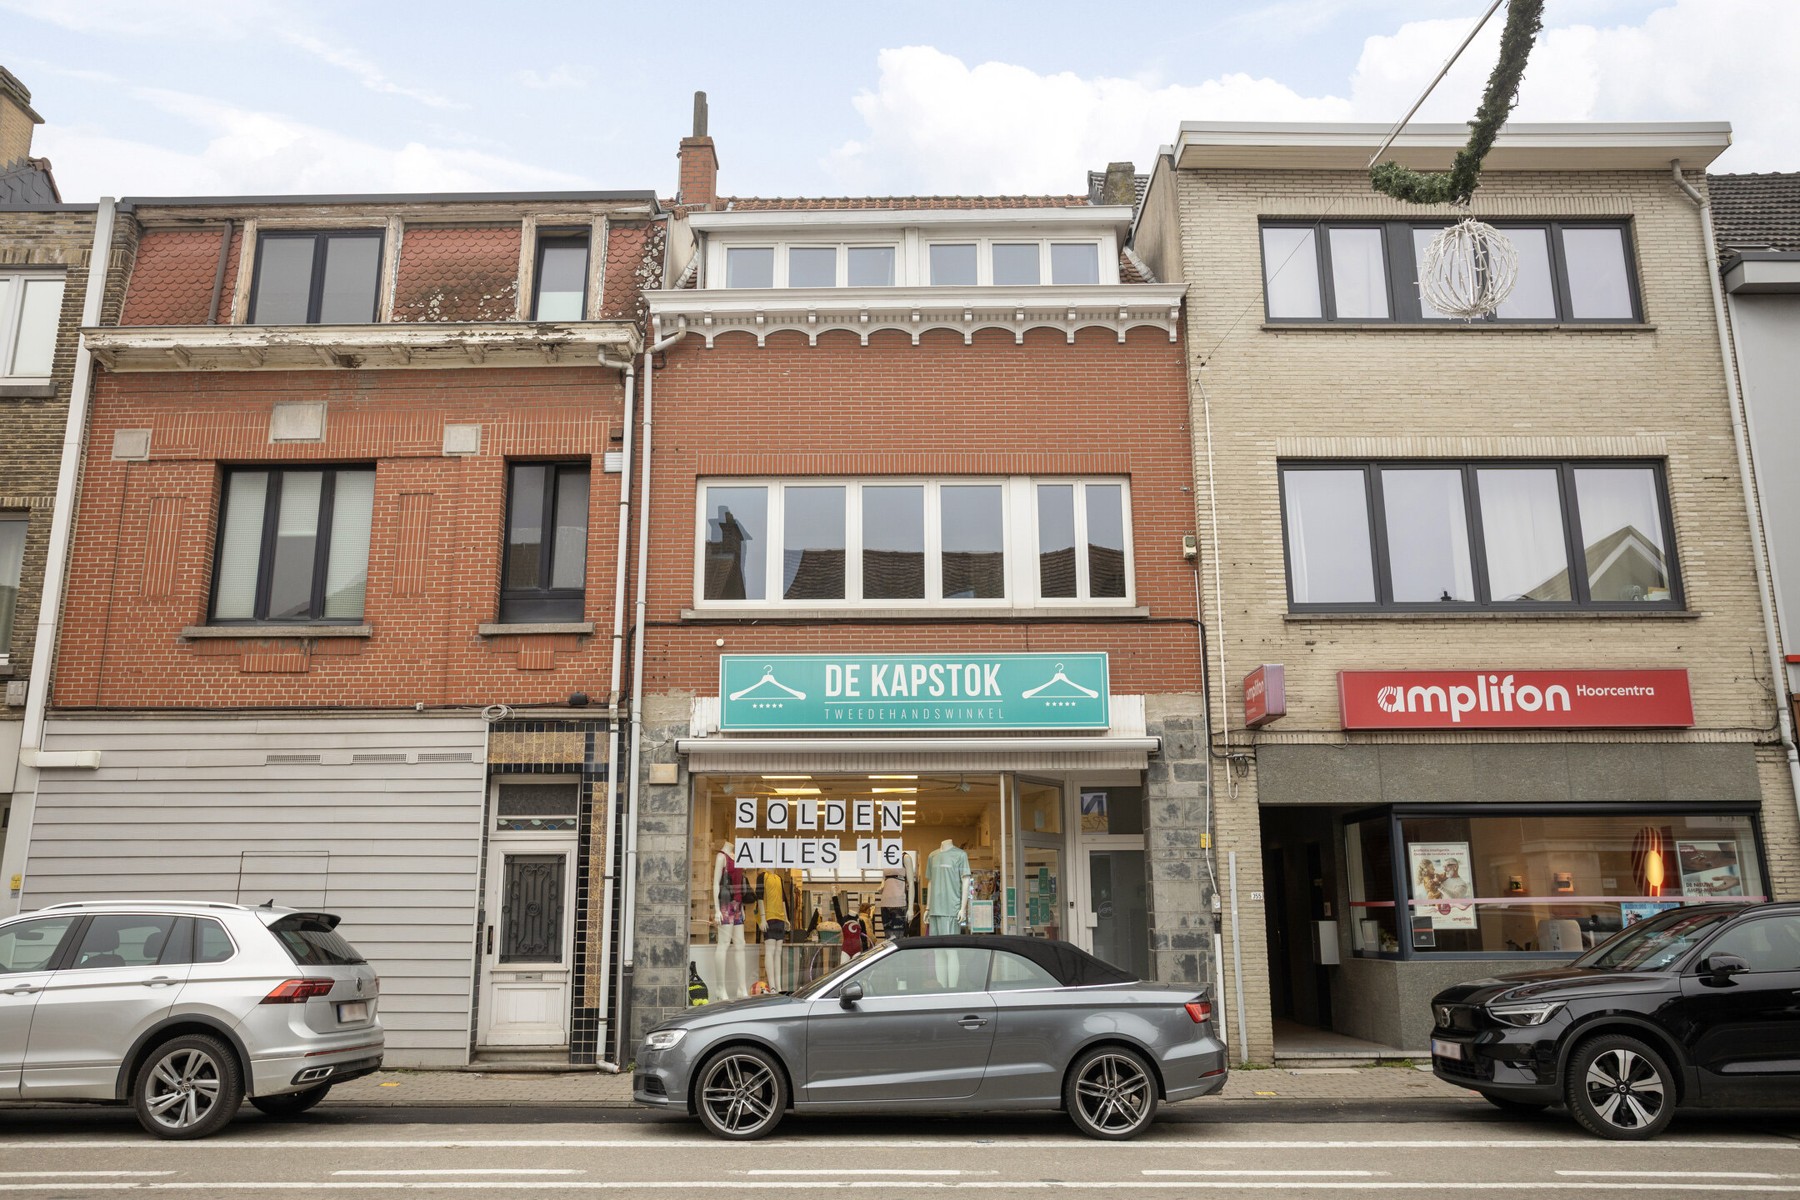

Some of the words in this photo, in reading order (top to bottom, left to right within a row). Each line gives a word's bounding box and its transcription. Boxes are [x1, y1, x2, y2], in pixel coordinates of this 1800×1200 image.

[825, 664, 860, 697] DE
[871, 663, 1002, 697] KAPSTOK
[1576, 684, 1655, 696] Hoorcentra
[1377, 675, 1571, 722] amplifon
[824, 708, 1004, 720] TWEEDEHANDSWINKEL
[738, 801, 901, 827] SOLDEN
[736, 842, 837, 864] ALLES
